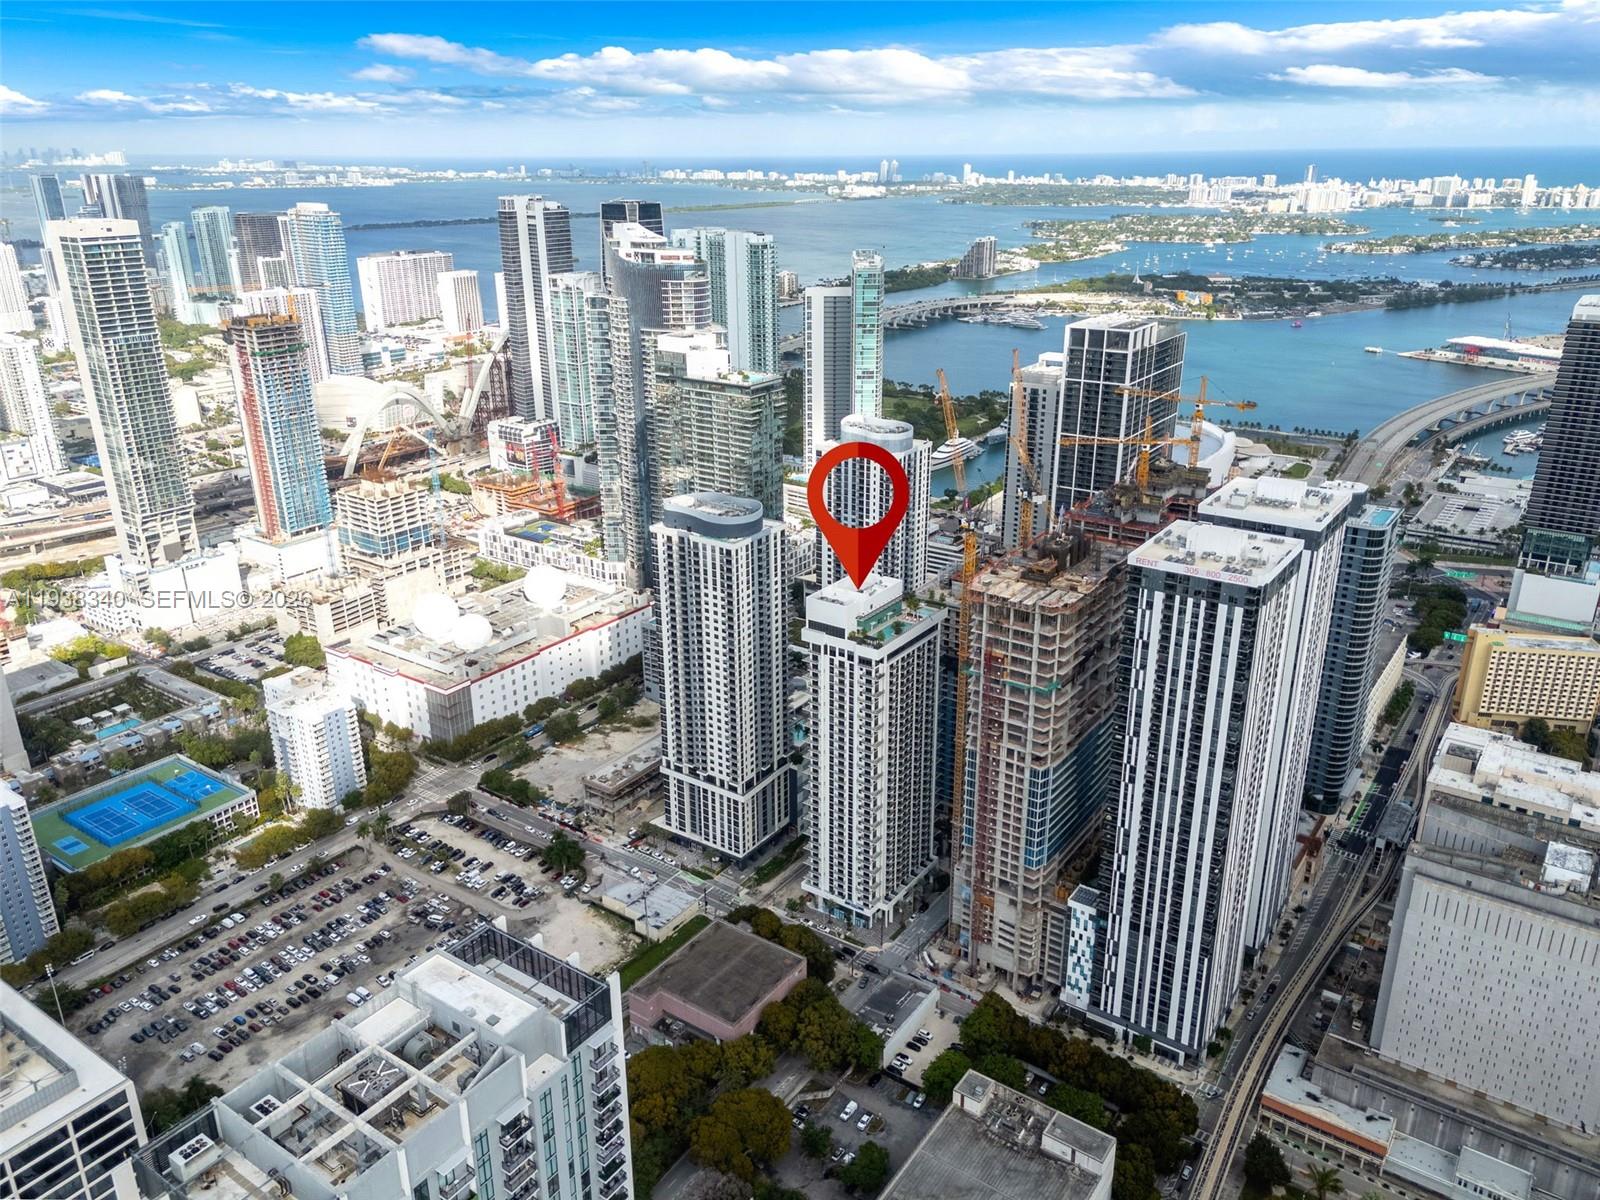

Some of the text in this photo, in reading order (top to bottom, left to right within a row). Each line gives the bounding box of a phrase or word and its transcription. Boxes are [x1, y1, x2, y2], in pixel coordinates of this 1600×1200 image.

[1135, 557, 1248, 584] RENT 305 800 2500
